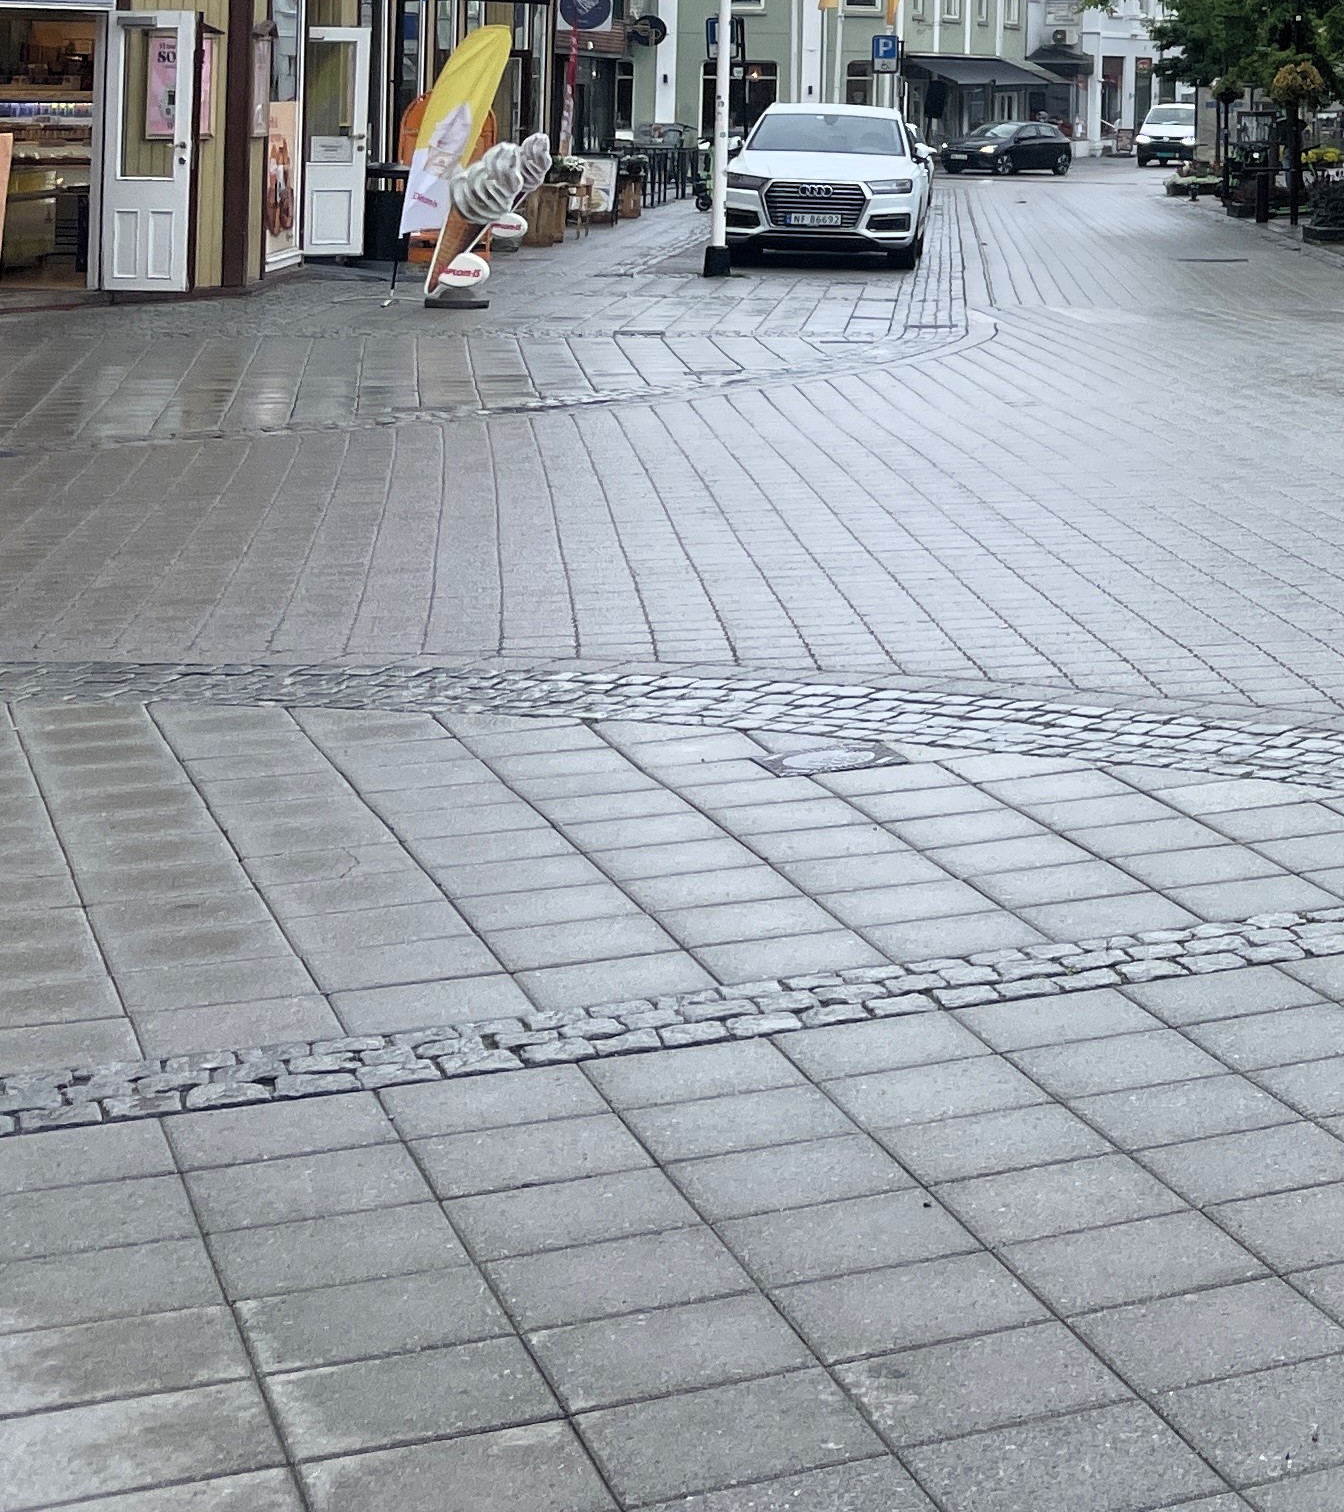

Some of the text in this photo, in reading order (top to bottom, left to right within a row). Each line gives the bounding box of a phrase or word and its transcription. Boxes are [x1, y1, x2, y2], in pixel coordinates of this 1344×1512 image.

[878, 39, 892, 57] P
[793, 215, 839, 224] NF 86692
